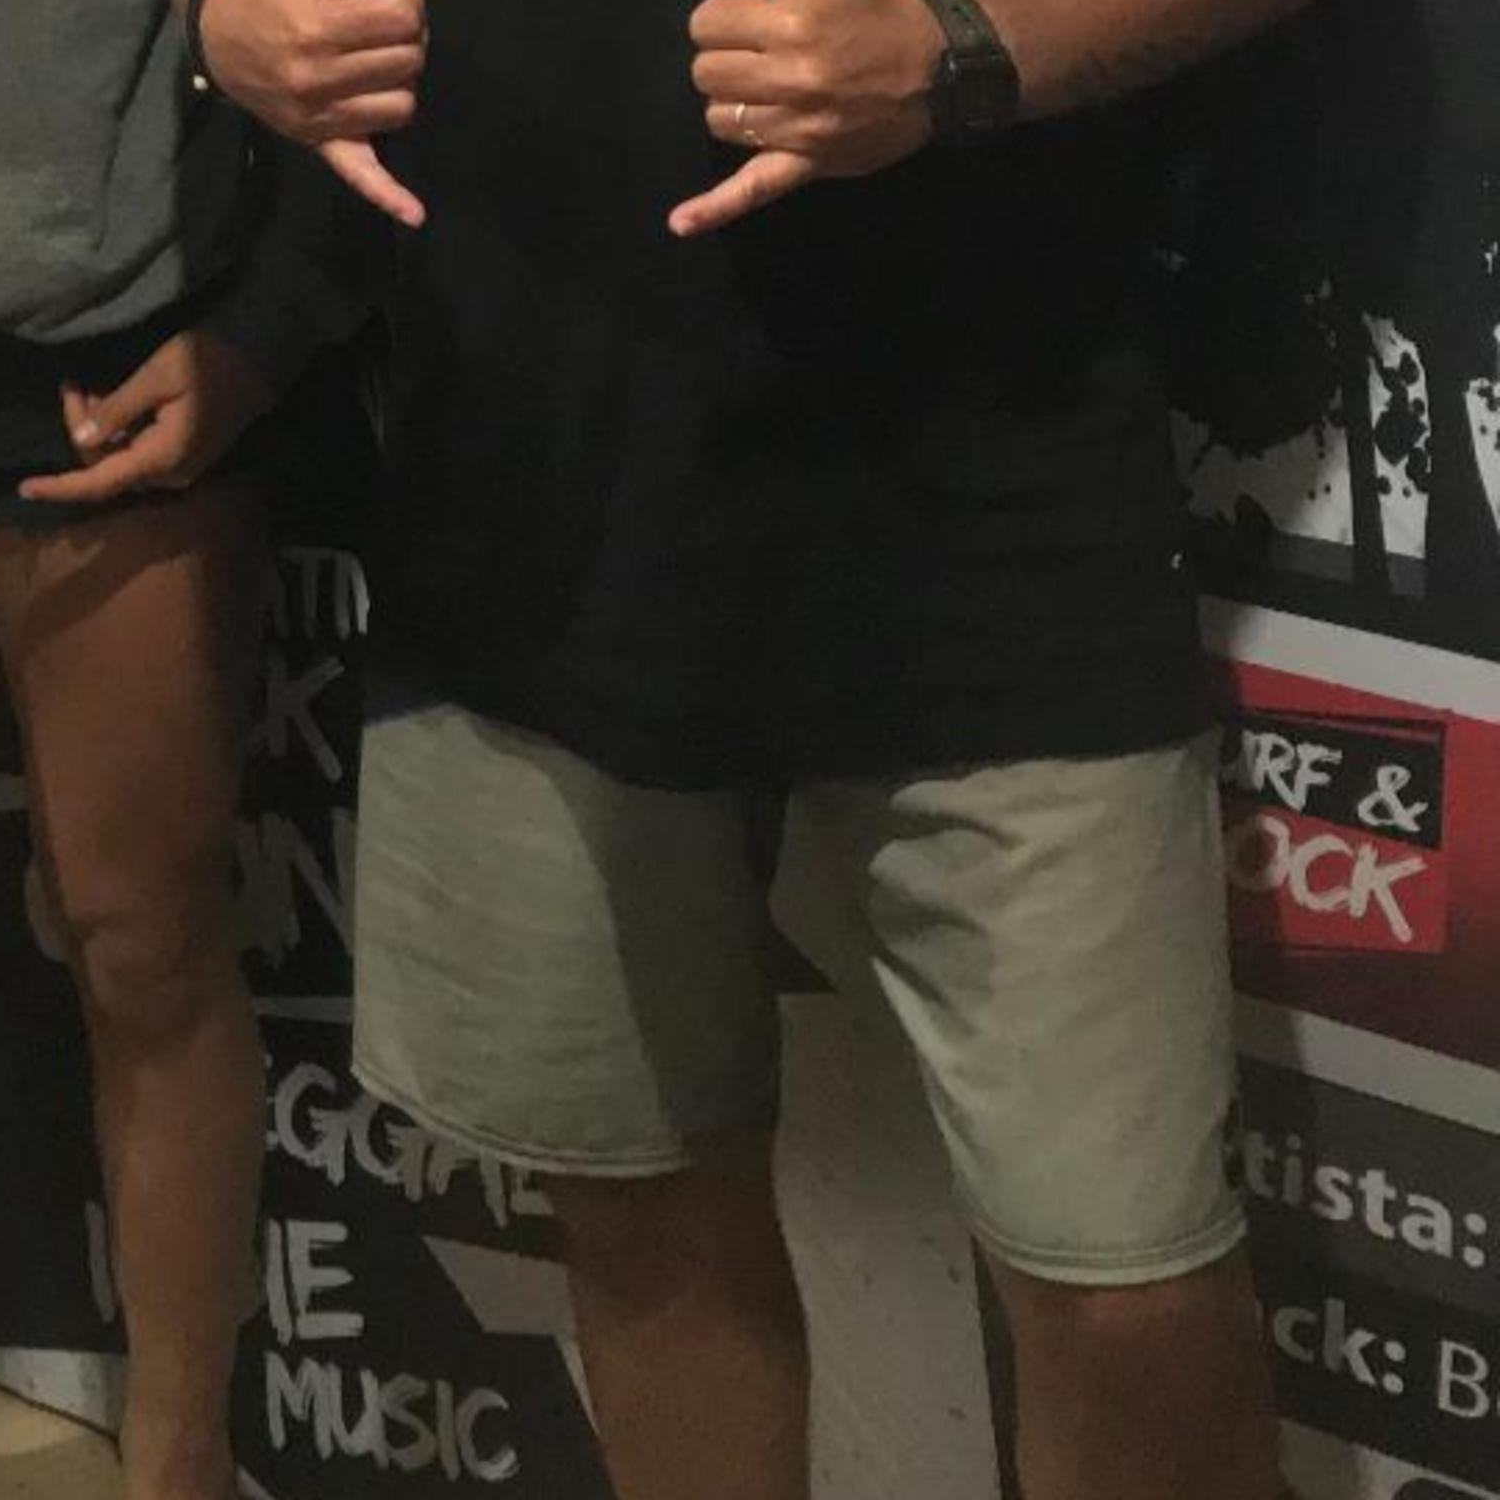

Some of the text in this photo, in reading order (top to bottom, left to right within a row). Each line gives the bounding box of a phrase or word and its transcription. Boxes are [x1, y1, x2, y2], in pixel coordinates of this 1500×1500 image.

[1356, 763, 1430, 833] &
[1228, 814, 1429, 944] OCK
[1242, 1129, 1488, 1269] tista:
[264, 1351, 521, 1483] MUSIC
